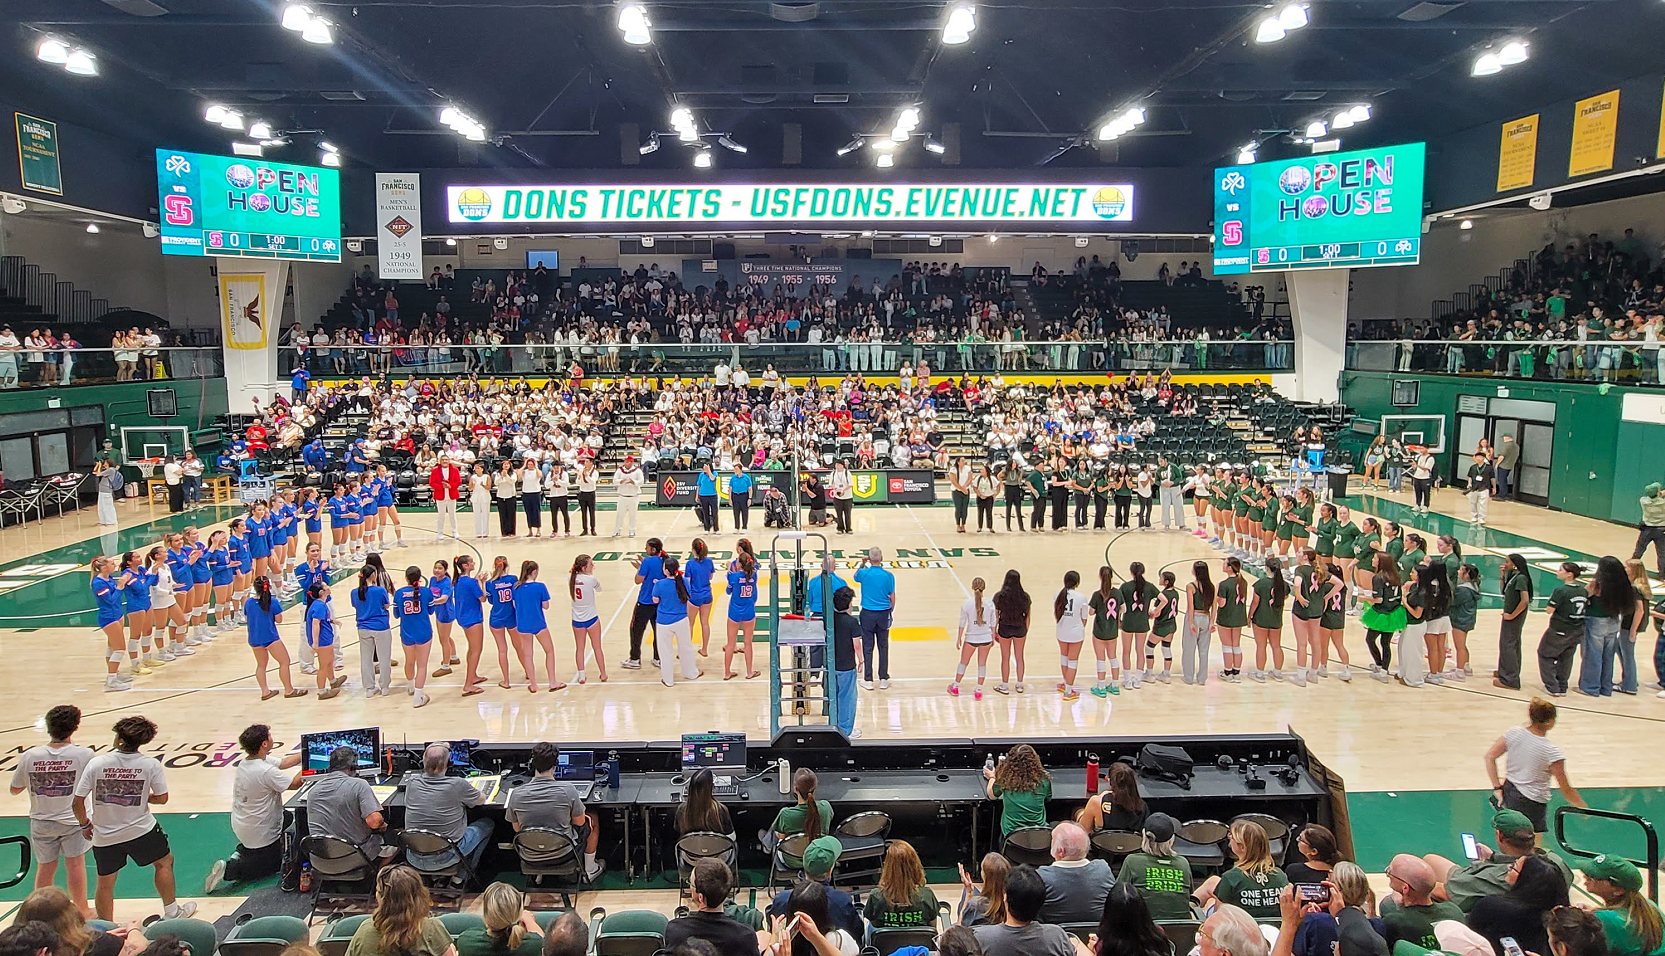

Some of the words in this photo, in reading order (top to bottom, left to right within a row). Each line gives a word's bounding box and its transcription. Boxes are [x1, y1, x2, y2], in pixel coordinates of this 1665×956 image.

[1580, 102, 1612, 117] FRANCISCO
[23, 124, 51, 140] FRANCISCO
[1507, 125, 1533, 138] FRANCISCO
[226, 164, 320, 197] OPEN
[1279, 155, 1395, 196] OPEN
[381, 183, 415, 191] FRANCISCO
[227, 191, 321, 217] HOUSE
[502, 189, 588, 220] DONS
[599, 188, 722, 219] TICKETS
[750, 187, 1087, 219] USFDONS.EVENUE.NET
[1279, 188, 1393, 222] HOUSE
[463, 209, 488, 217] DONS
[1096, 207, 1121, 216] DONS
[229, 233, 240, 247] 0
[265, 235, 286, 245] 1:00
[311, 238, 320, 251] 0
[390, 251, 411, 260] 1949
[1279, 248, 1287, 262] 0
[1319, 244, 1341, 255] 1:00
[1377, 242, 1387, 256] 0
[749, 275, 769, 284] 1949
[782, 275, 803, 284] 1955
[815, 275, 837, 284] 1956
[498, 589, 512, 602] 18
[740, 585, 753, 597] 12
[1145, 867, 1184, 880] IRISH
[1145, 880, 1184, 892] PRIDE
[1240, 890, 1262, 898] ONE
[1240, 897, 1262, 907] ONE
[1263, 896, 1281, 906] HEA
[883, 910, 923, 923] IRISH
